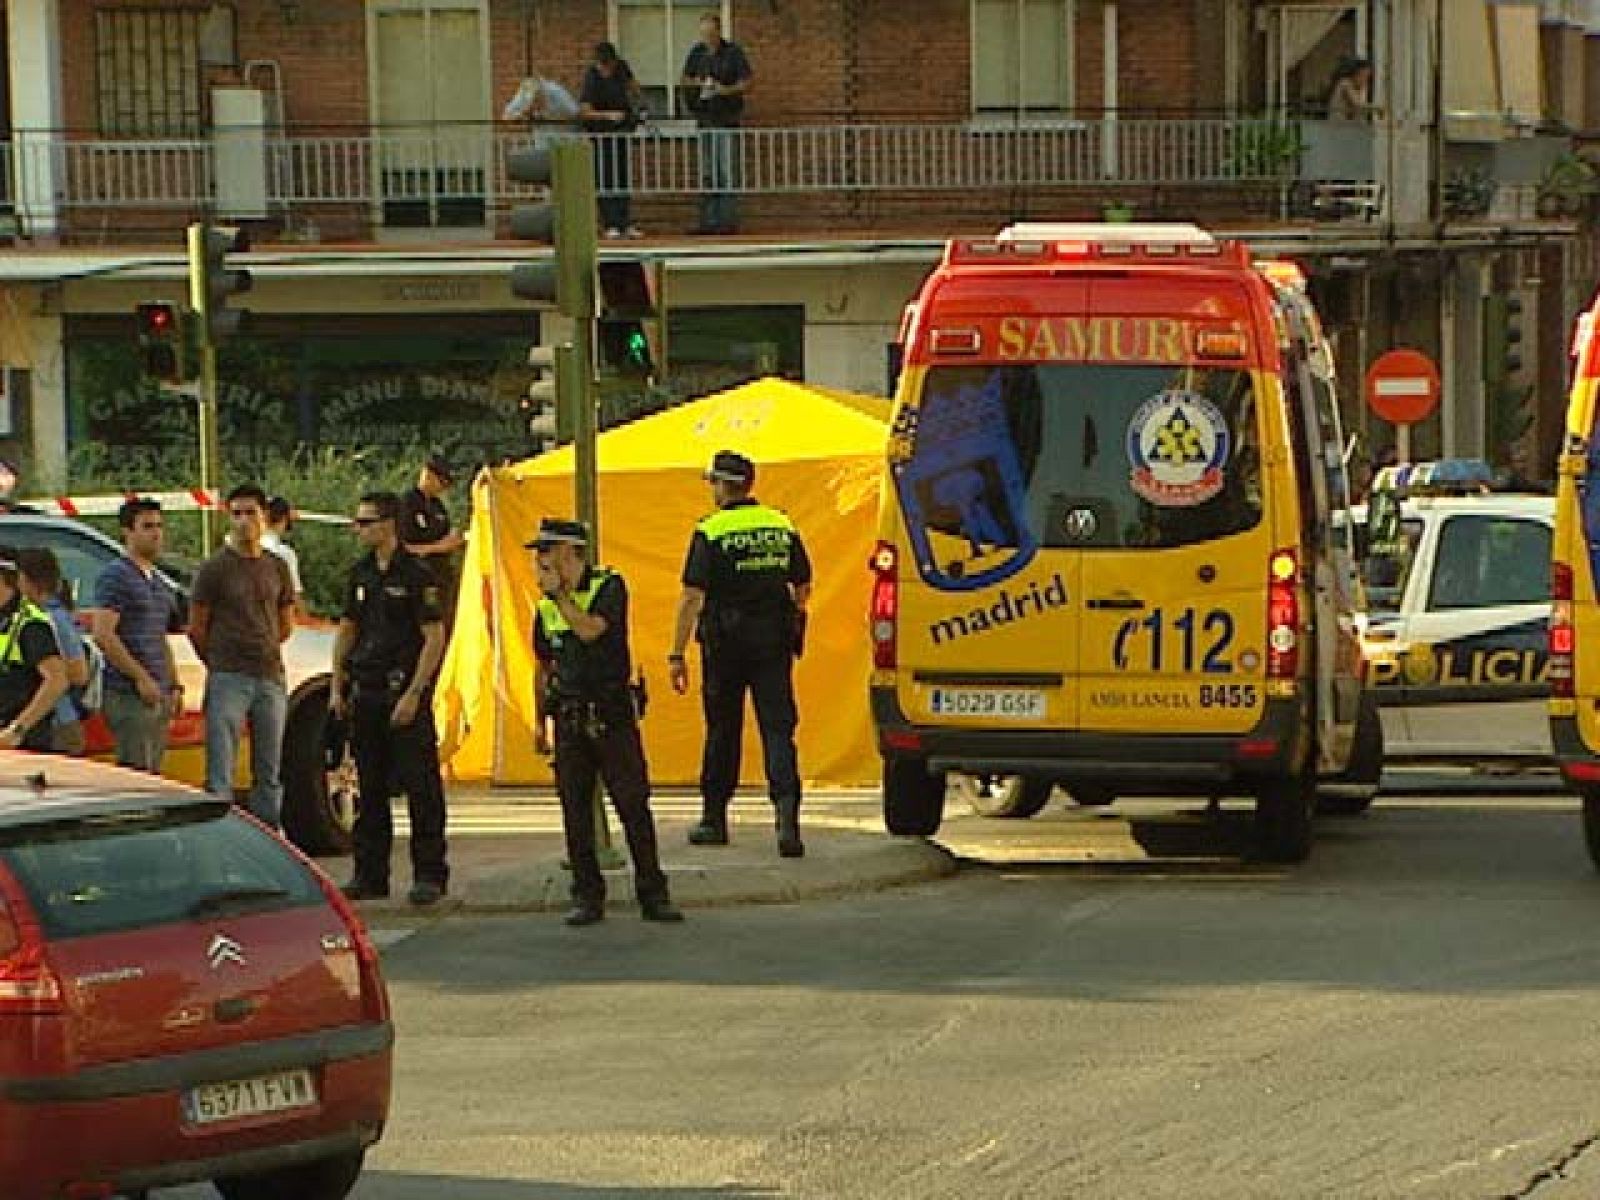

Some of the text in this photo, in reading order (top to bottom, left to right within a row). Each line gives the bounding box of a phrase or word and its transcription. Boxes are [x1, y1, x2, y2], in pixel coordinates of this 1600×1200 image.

[999, 317, 1185, 361] SAMUR
[89, 372, 285, 423] CAFERIA
[321, 376, 402, 423] MENU
[721, 530, 792, 552] POLICIA
[929, 574, 1068, 644] madrid
[1142, 608, 1235, 673] 112
[1199, 685, 1256, 709] 8455
[199, 1082, 256, 1116] 6371
